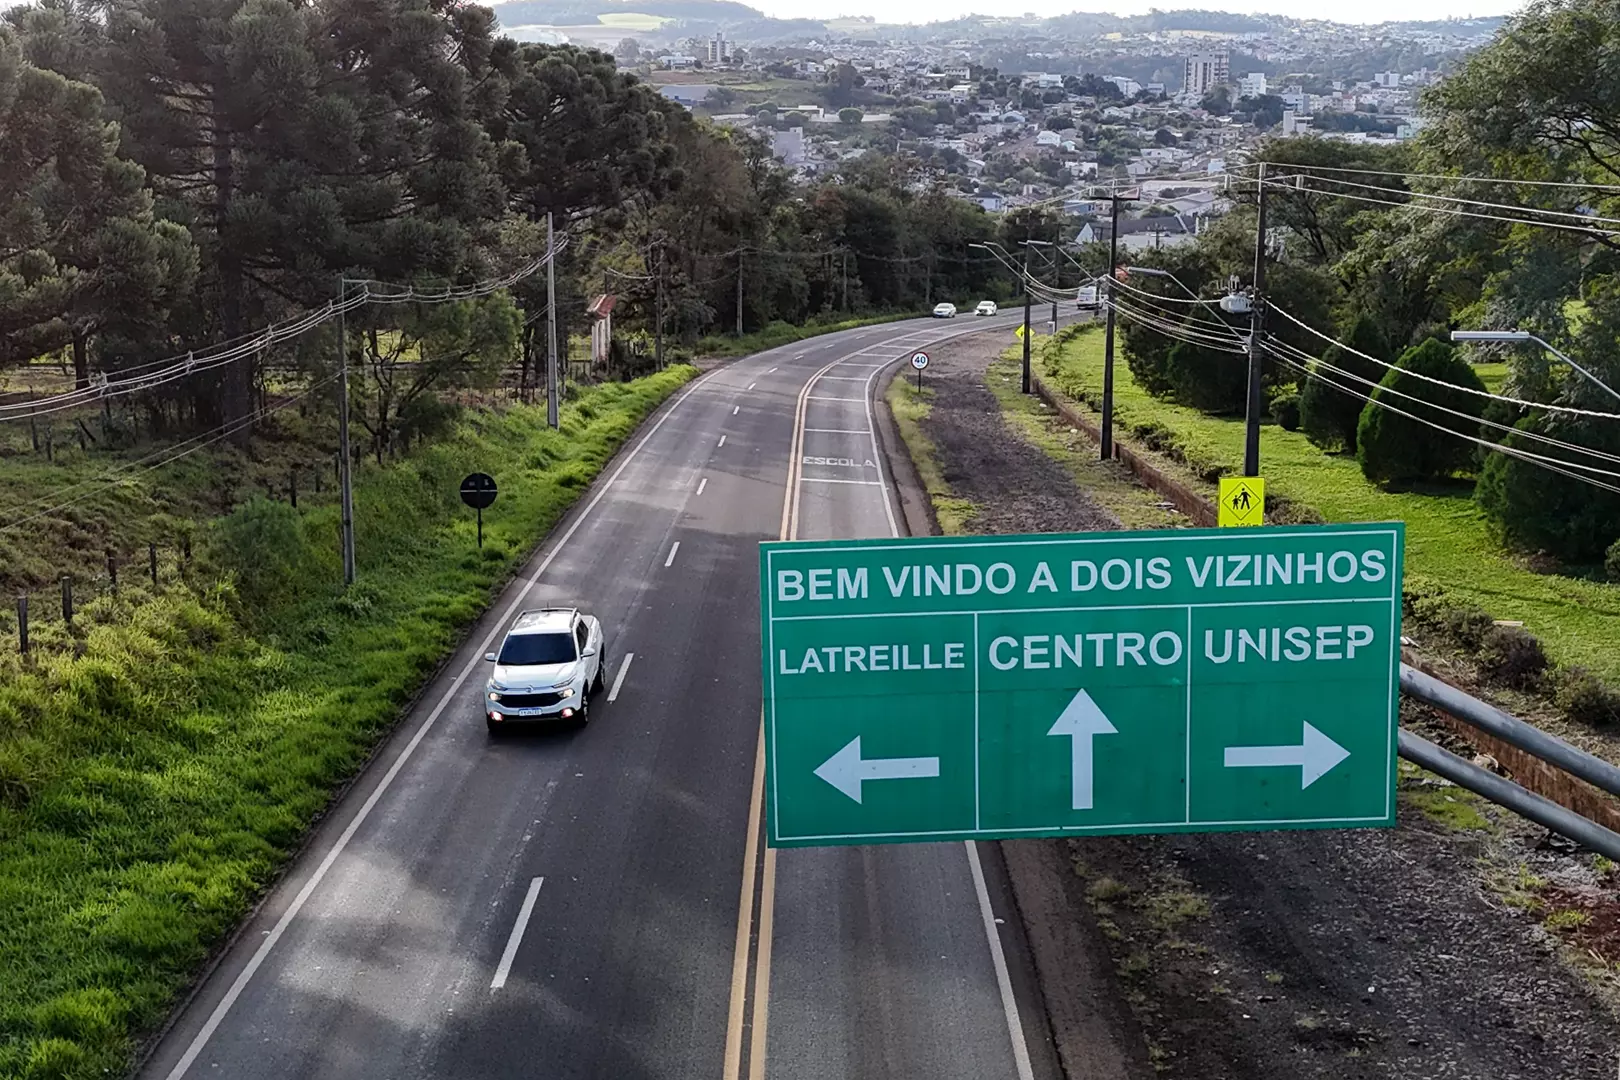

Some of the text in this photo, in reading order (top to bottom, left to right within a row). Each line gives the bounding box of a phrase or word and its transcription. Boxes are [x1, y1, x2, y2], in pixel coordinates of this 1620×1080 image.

[914, 356, 926, 364] 40
[802, 456, 877, 468] ESCOLA
[778, 549, 1387, 601] BEM VINDO A DOIS VIZINHOS
[780, 643, 965, 674] LATREILLE
[989, 630, 1182, 669] CENTRO
[1205, 625, 1374, 664] UNISEP
